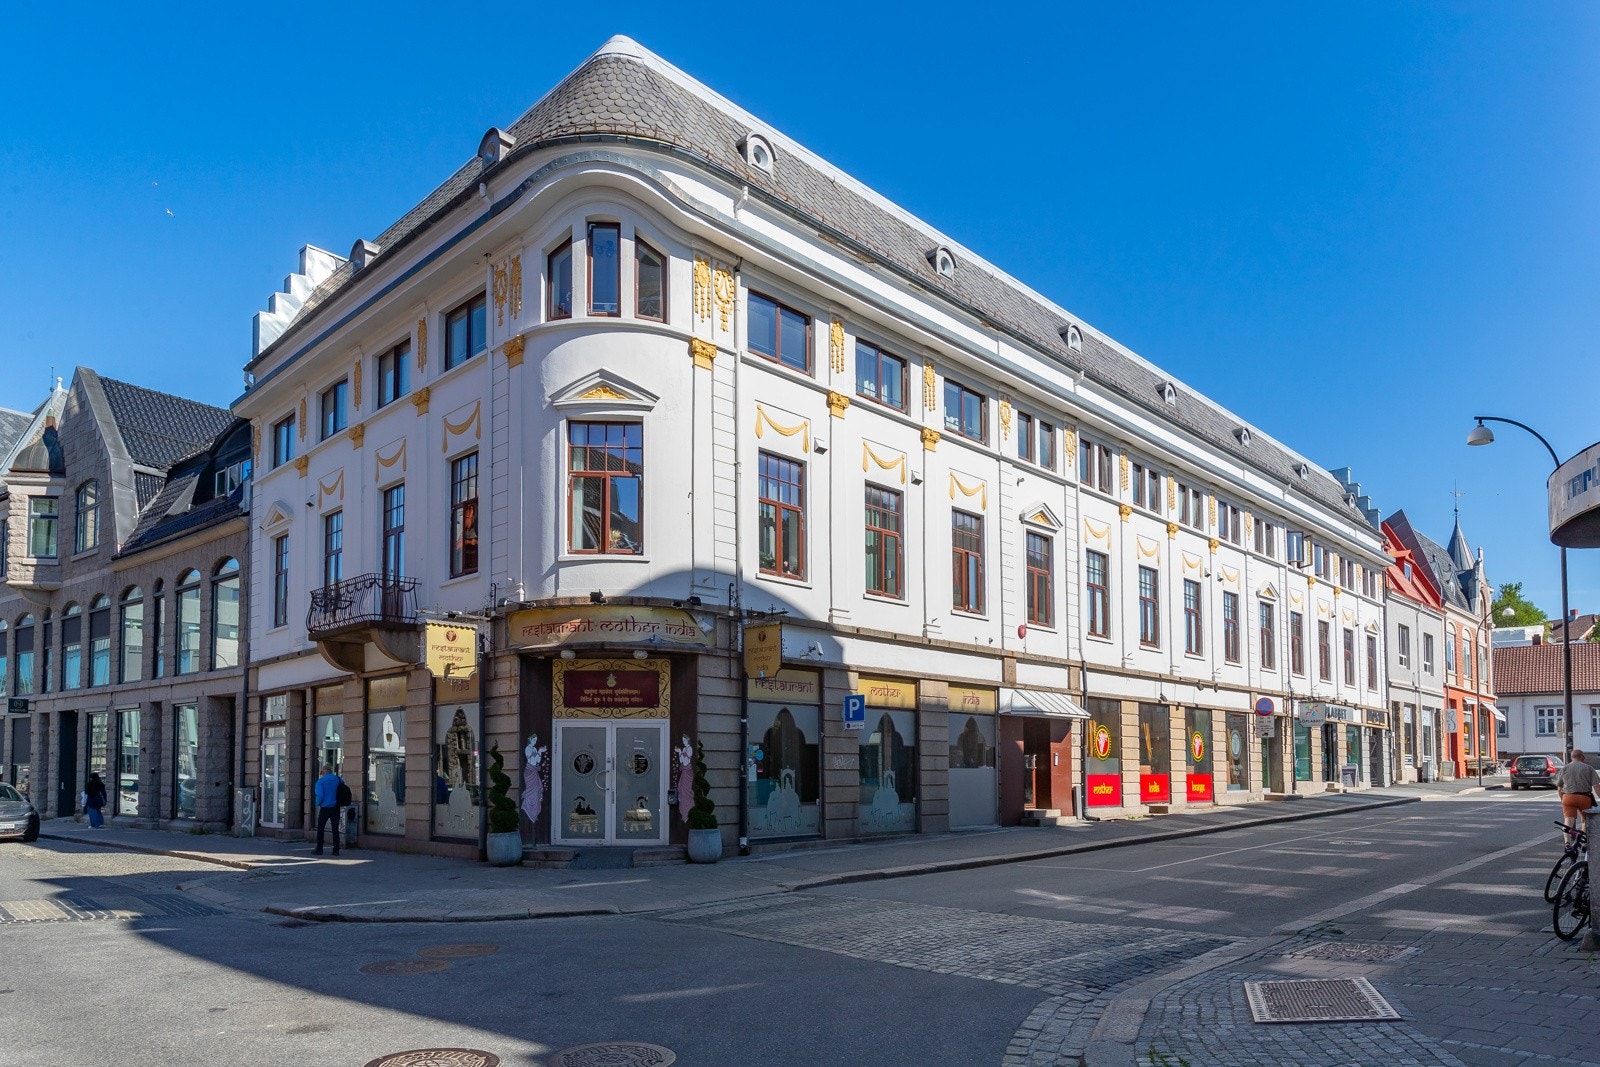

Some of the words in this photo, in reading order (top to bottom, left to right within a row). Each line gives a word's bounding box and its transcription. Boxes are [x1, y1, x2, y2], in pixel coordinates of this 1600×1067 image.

[522, 618, 595, 637] restaurant
[599, 616, 662, 633] mother
[665, 618, 697, 637] india
[755, 678, 815, 694] restaurant
[870, 683, 901, 698] mother
[962, 690, 980, 706] india
[849, 698, 860, 719] P
